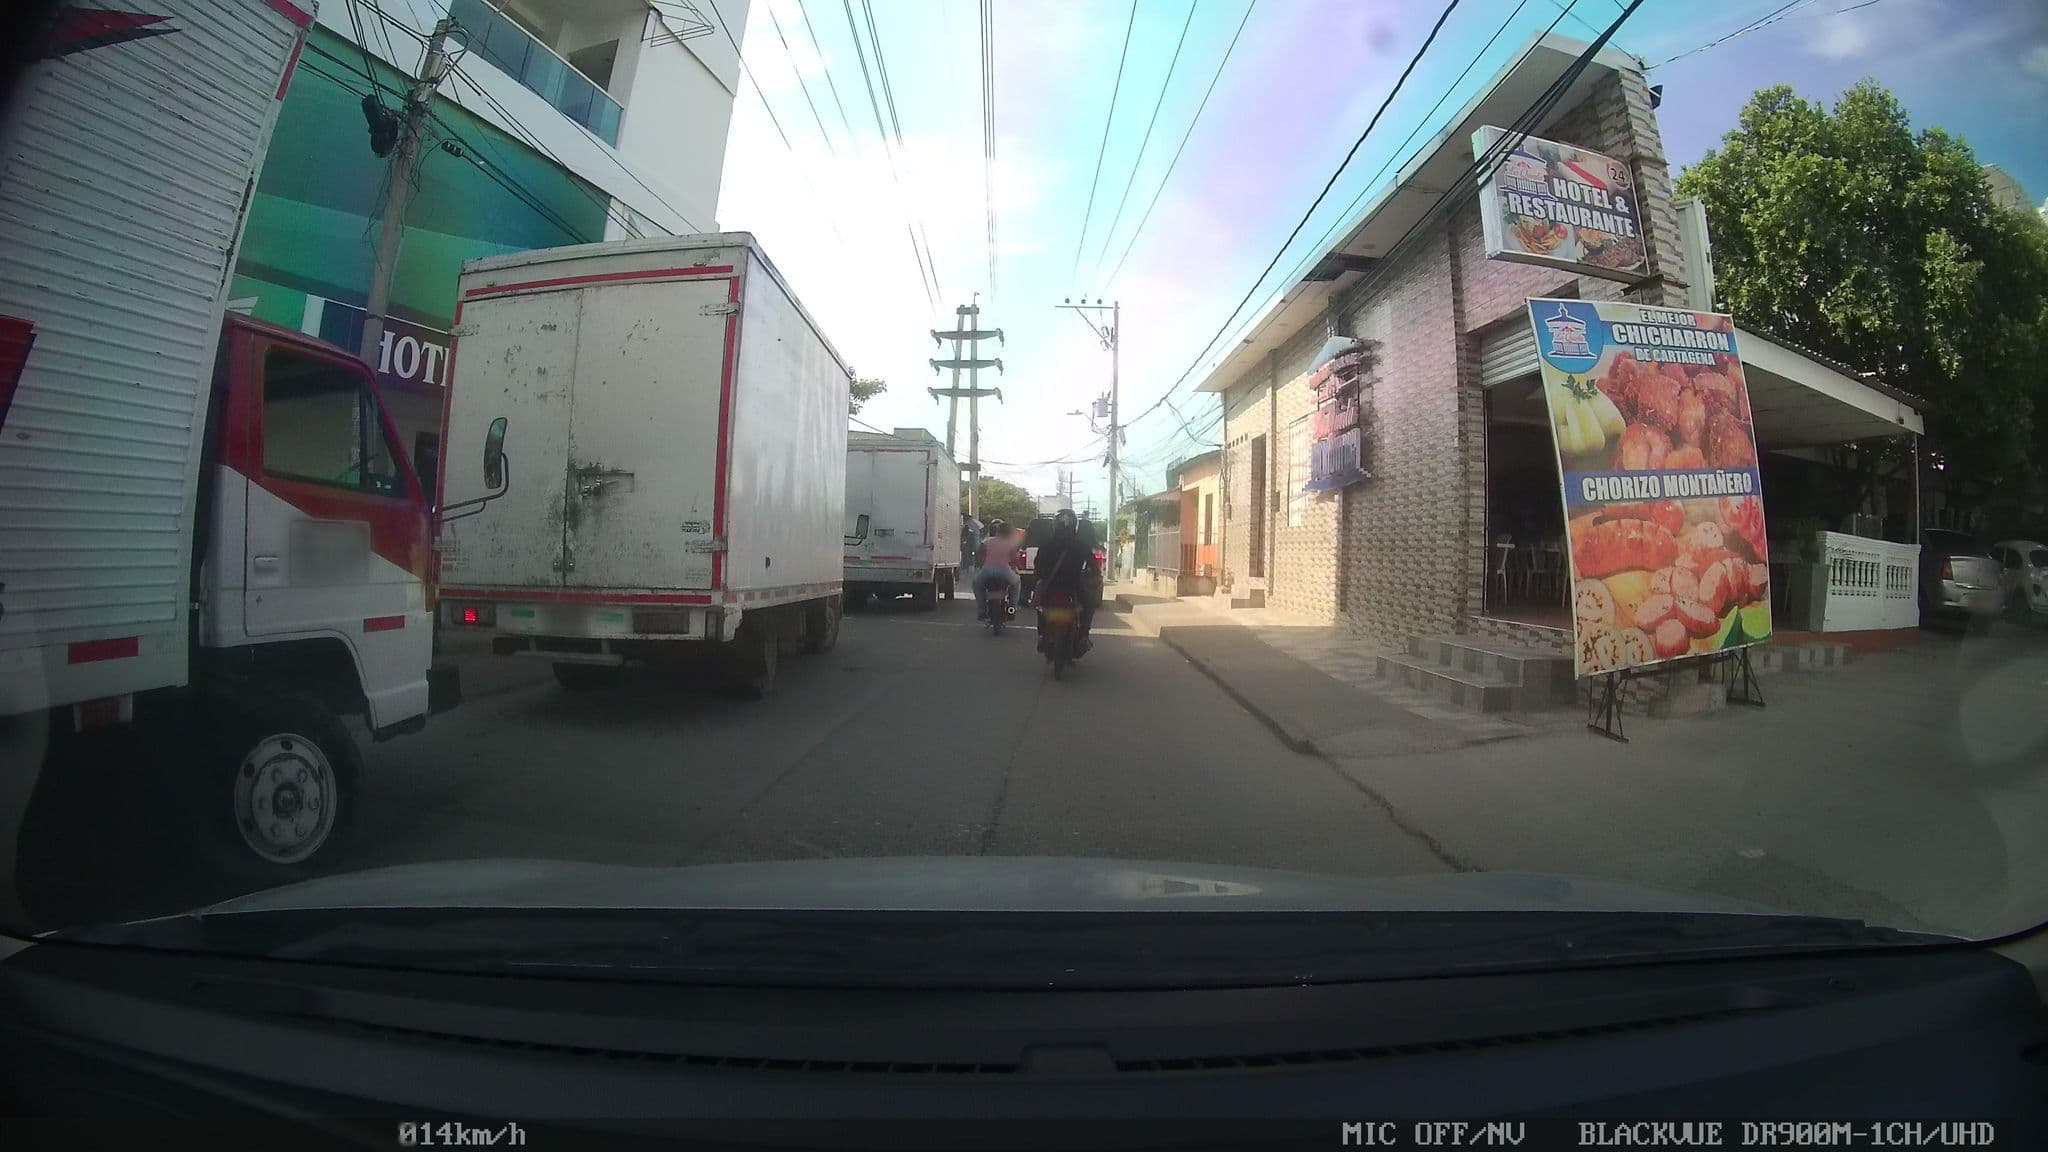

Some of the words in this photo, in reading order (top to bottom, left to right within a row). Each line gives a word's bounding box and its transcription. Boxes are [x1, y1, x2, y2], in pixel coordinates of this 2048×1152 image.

[1610, 166, 1626, 183] 24
[1552, 177, 1613, 210] HOTEL
[1614, 196, 1631, 214] &
[1508, 192, 1636, 238] RESTAURANTE
[1639, 309, 1655, 323] EL
[1655, 310, 1697, 327] MEJOR
[1611, 323, 1730, 351] CHICHARRON
[1635, 347, 1651, 362] DE
[1653, 349, 1716, 366] CARTAGENA
[1582, 475, 1661, 501] CHORIZO
[1663, 469, 1753, 497] MONTAÑERO
